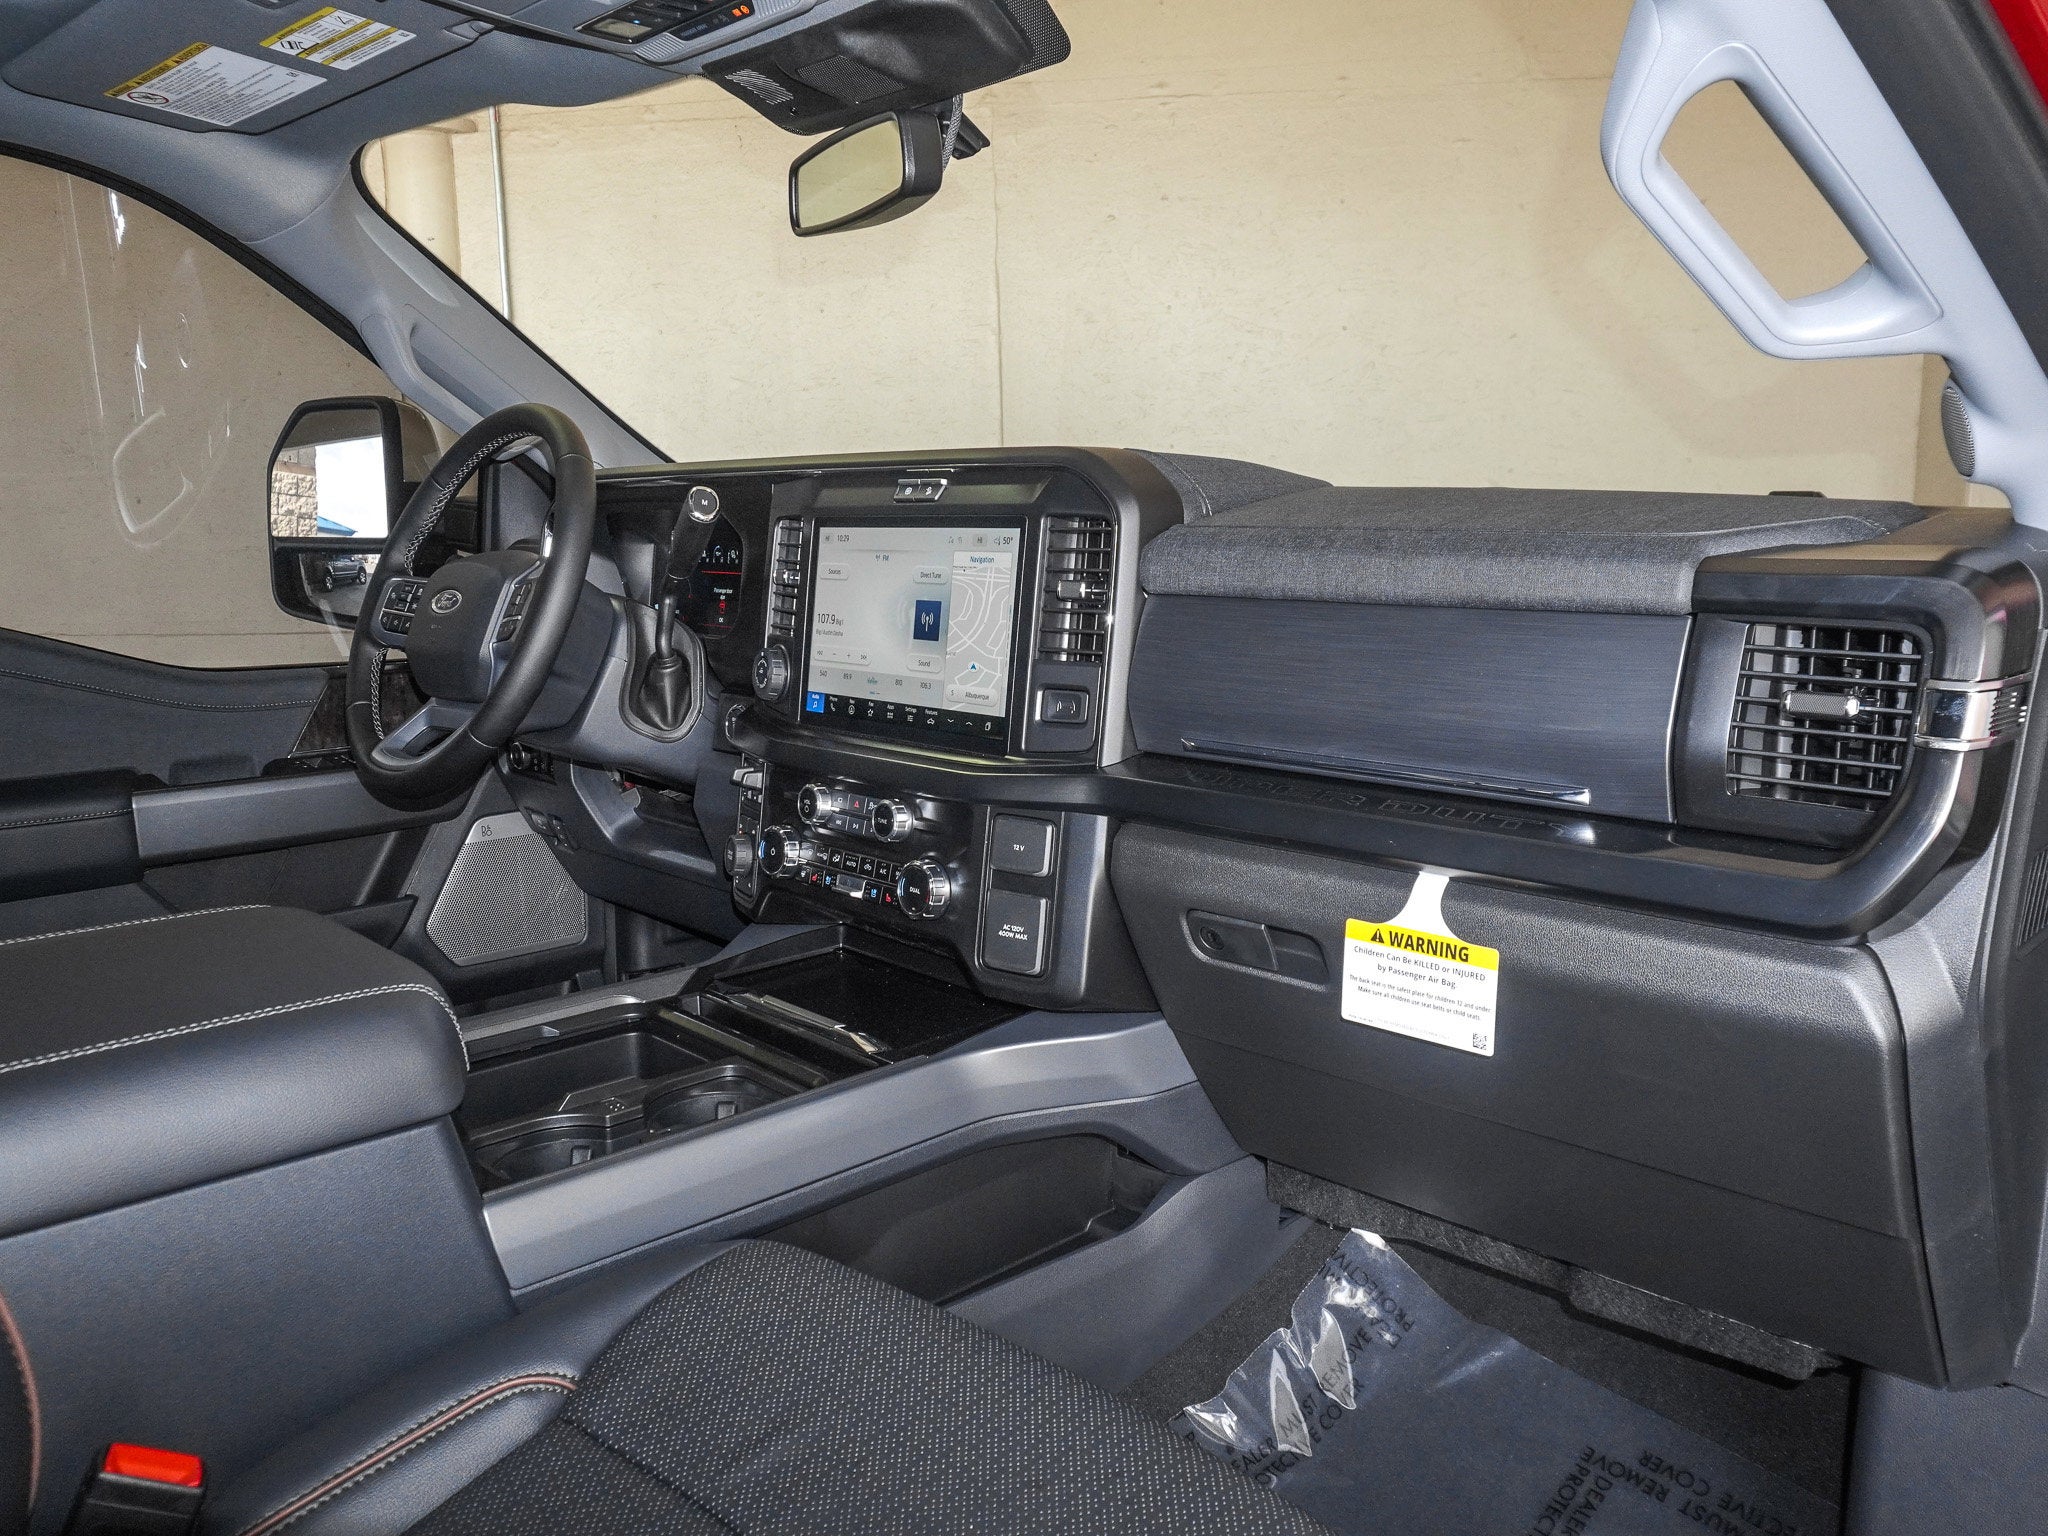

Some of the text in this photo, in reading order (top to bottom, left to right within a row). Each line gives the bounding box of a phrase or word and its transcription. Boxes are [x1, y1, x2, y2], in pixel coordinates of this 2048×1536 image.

[816, 613, 836, 625] 107.9
[1014, 932, 1029, 941] MAX
[1389, 931, 1469, 962] WARNING
[1353, 945, 1386, 959] Children
[1386, 952, 1402, 962] Can
[1402, 956, 1412, 965] Be
[1413, 959, 1440, 971] KILLED
[1452, 967, 1487, 982] INJURED
[1377, 963, 1387, 974] by
[1388, 966, 1426, 981] Passenger
[1428, 975, 1439, 984] Air
[1332, 1251, 1416, 1333] PROTECTIV
[1636, 1450, 1711, 1497] COVER
